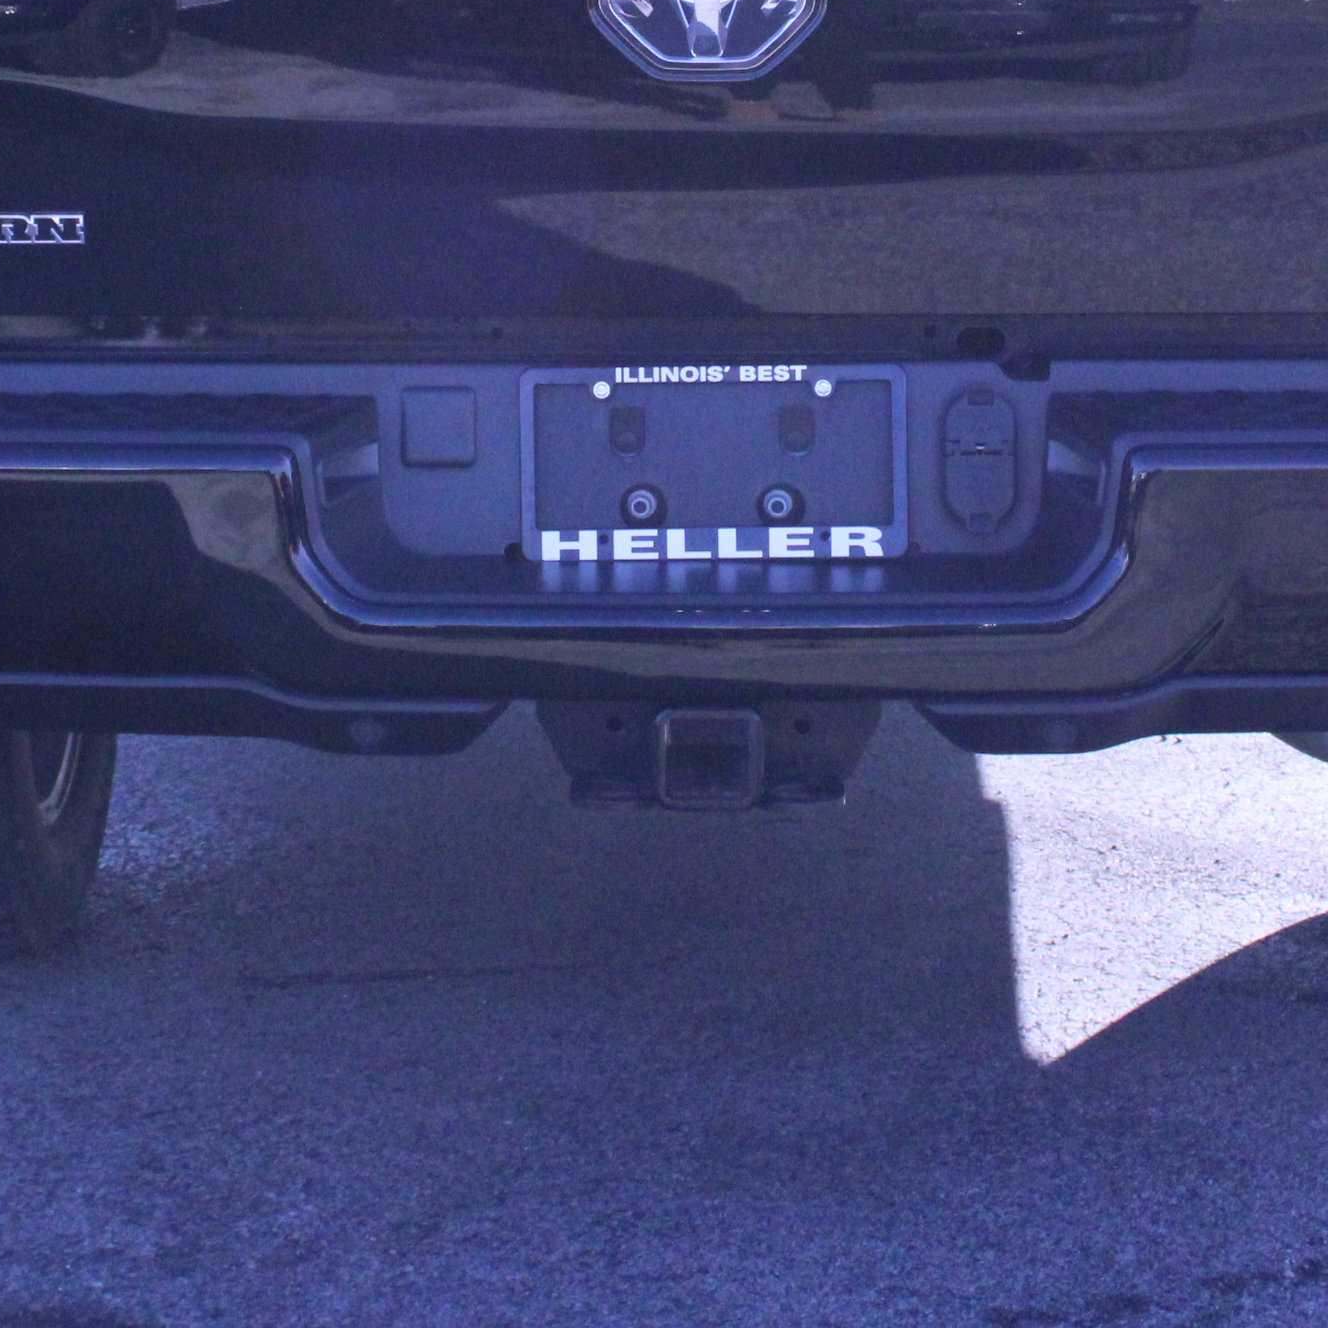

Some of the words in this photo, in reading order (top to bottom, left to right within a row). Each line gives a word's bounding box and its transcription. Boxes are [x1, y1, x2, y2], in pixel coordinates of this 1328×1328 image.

[615, 365, 732, 384] ILLINOIS'
[739, 365, 808, 382] BEST
[541, 526, 885, 561] HELLER
